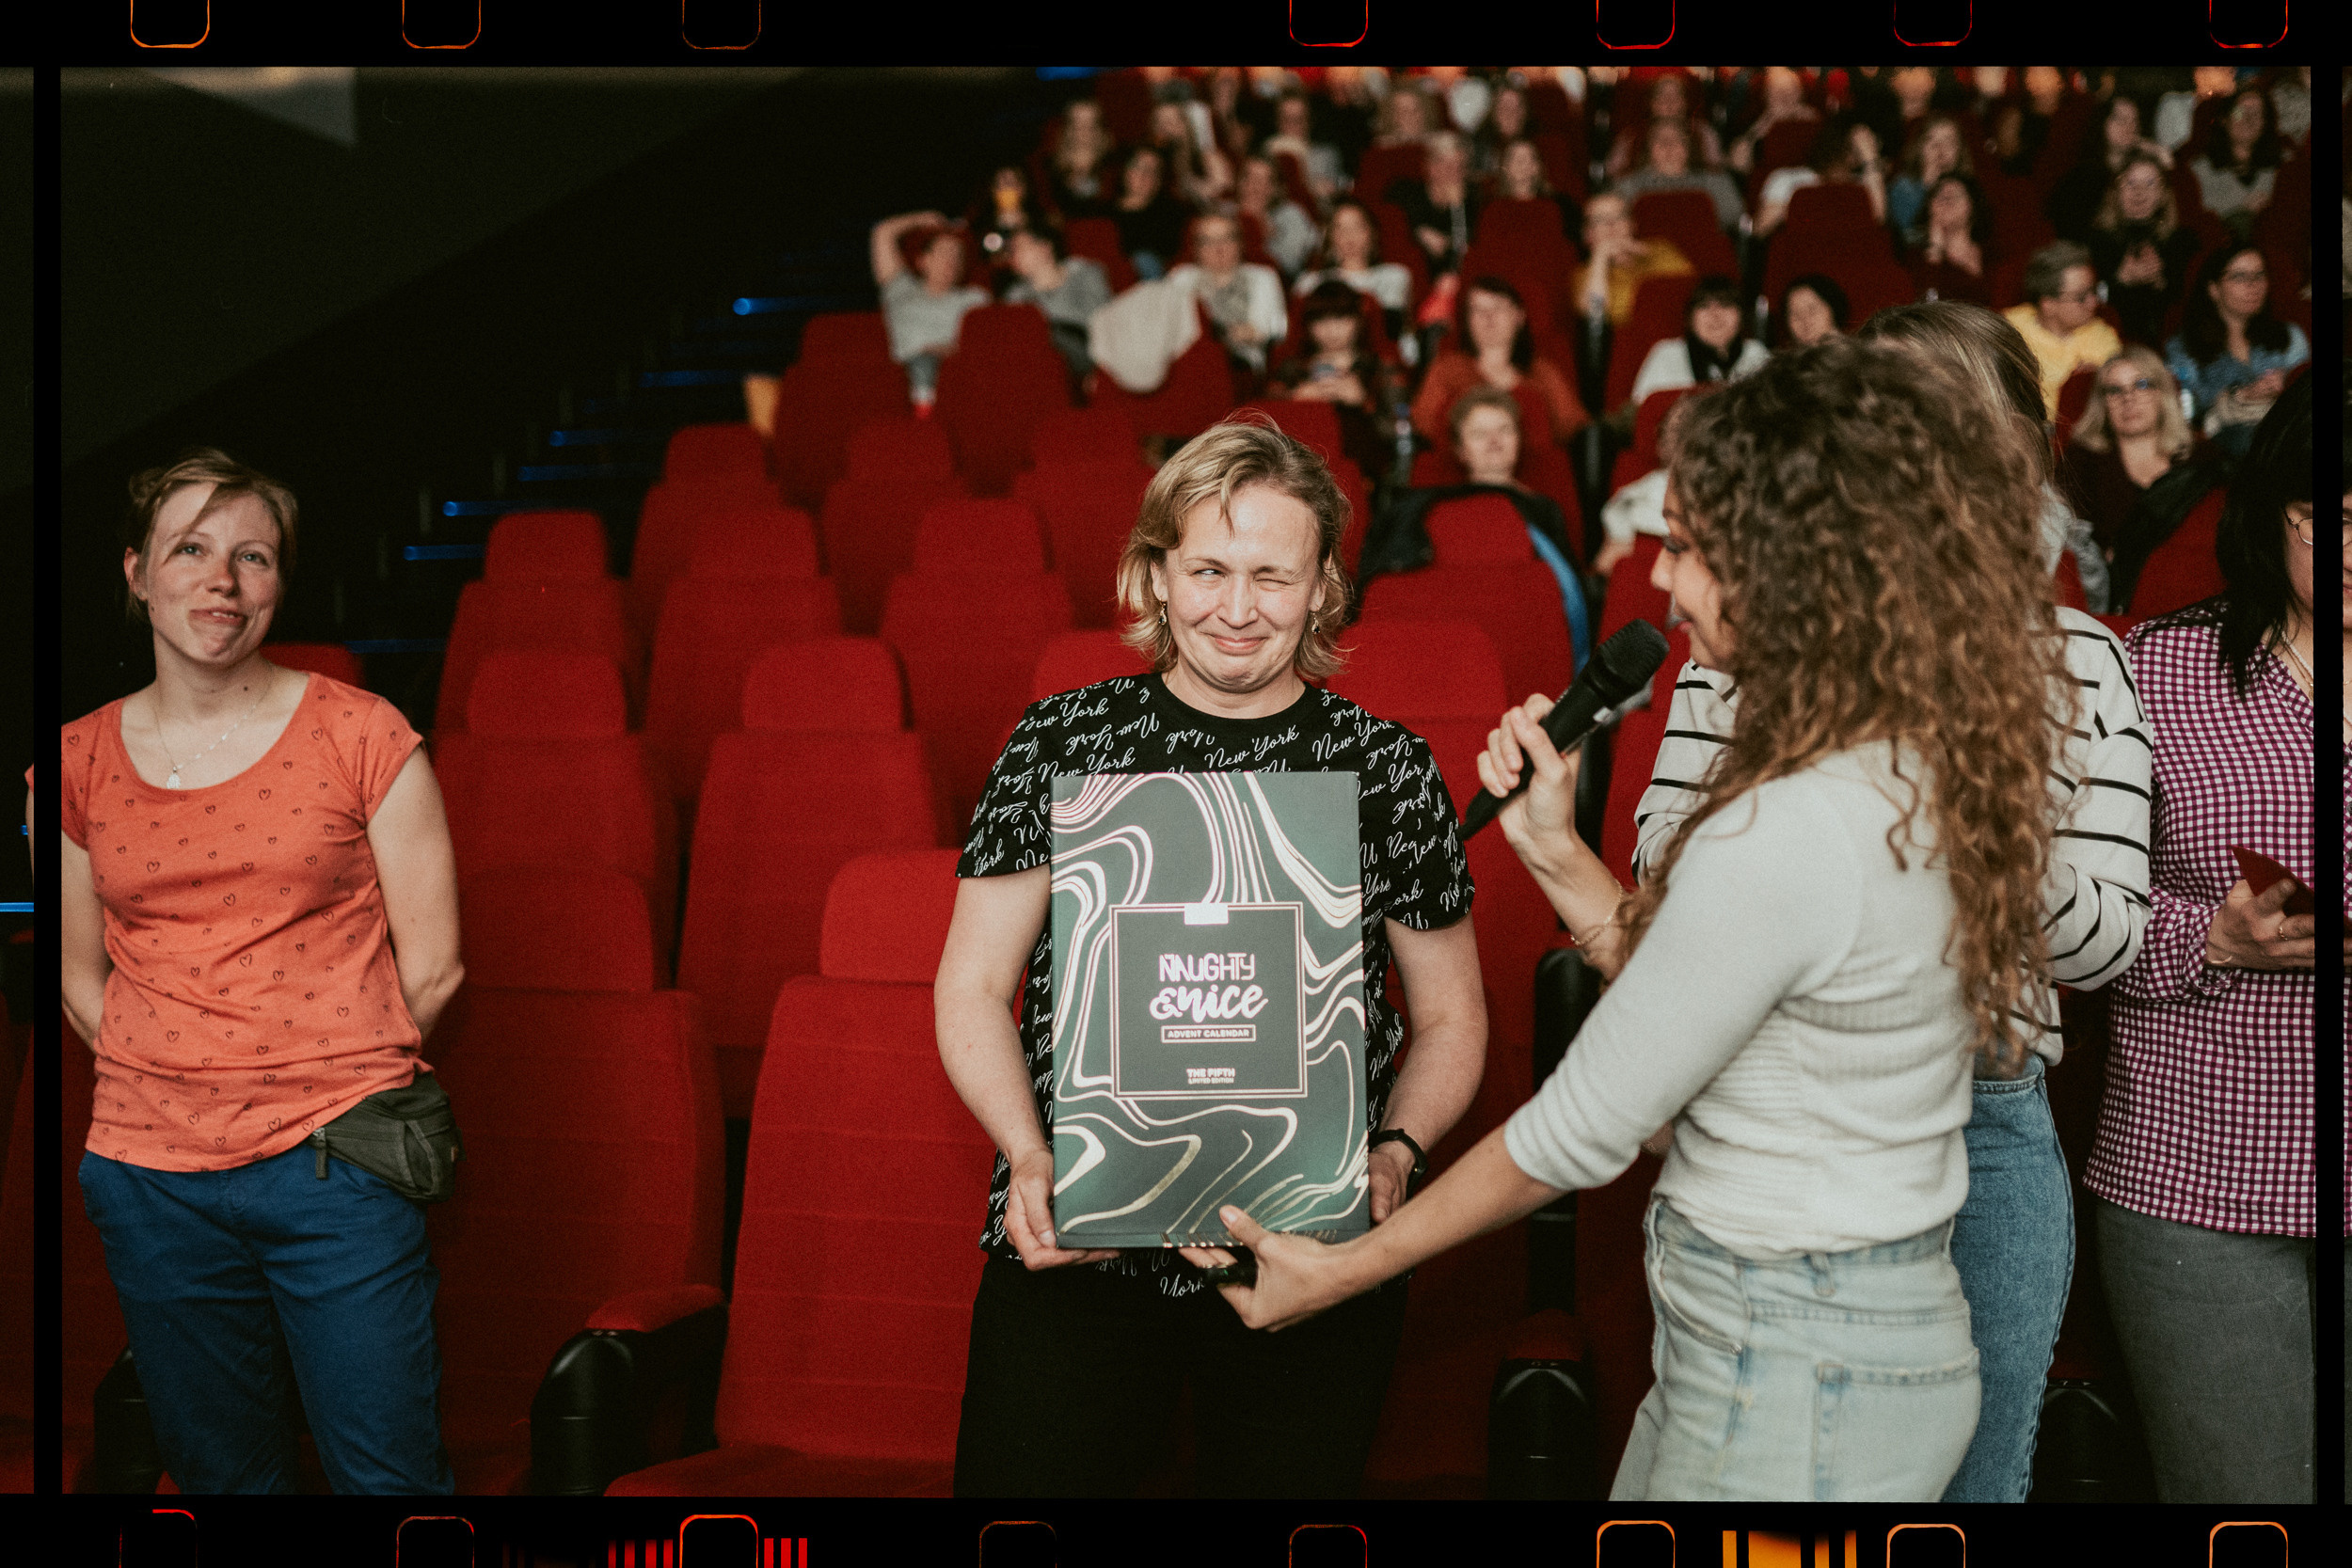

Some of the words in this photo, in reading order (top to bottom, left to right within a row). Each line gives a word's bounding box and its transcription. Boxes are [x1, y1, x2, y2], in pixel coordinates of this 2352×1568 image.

[1059, 698, 1109, 727] York
[1116, 712, 1160, 738] New
[1065, 724, 1114, 755] York
[1204, 748, 1250, 769] New
[1251, 724, 1300, 761] York
[1312, 733, 1356, 762] New
[1366, 734, 1413, 770] York
[1038, 760, 1083, 783] New
[1085, 747, 1136, 775] York
[1389, 760, 1424, 793] Yor
[1158, 952, 1256, 983] NAUGHTY
[1168, 1029, 1202, 1038] ADVENT
[1202, 1028, 1250, 1038] CALENDAR
[1186, 1067, 1207, 1078] THE
[1207, 1067, 1236, 1078] FIFTH
